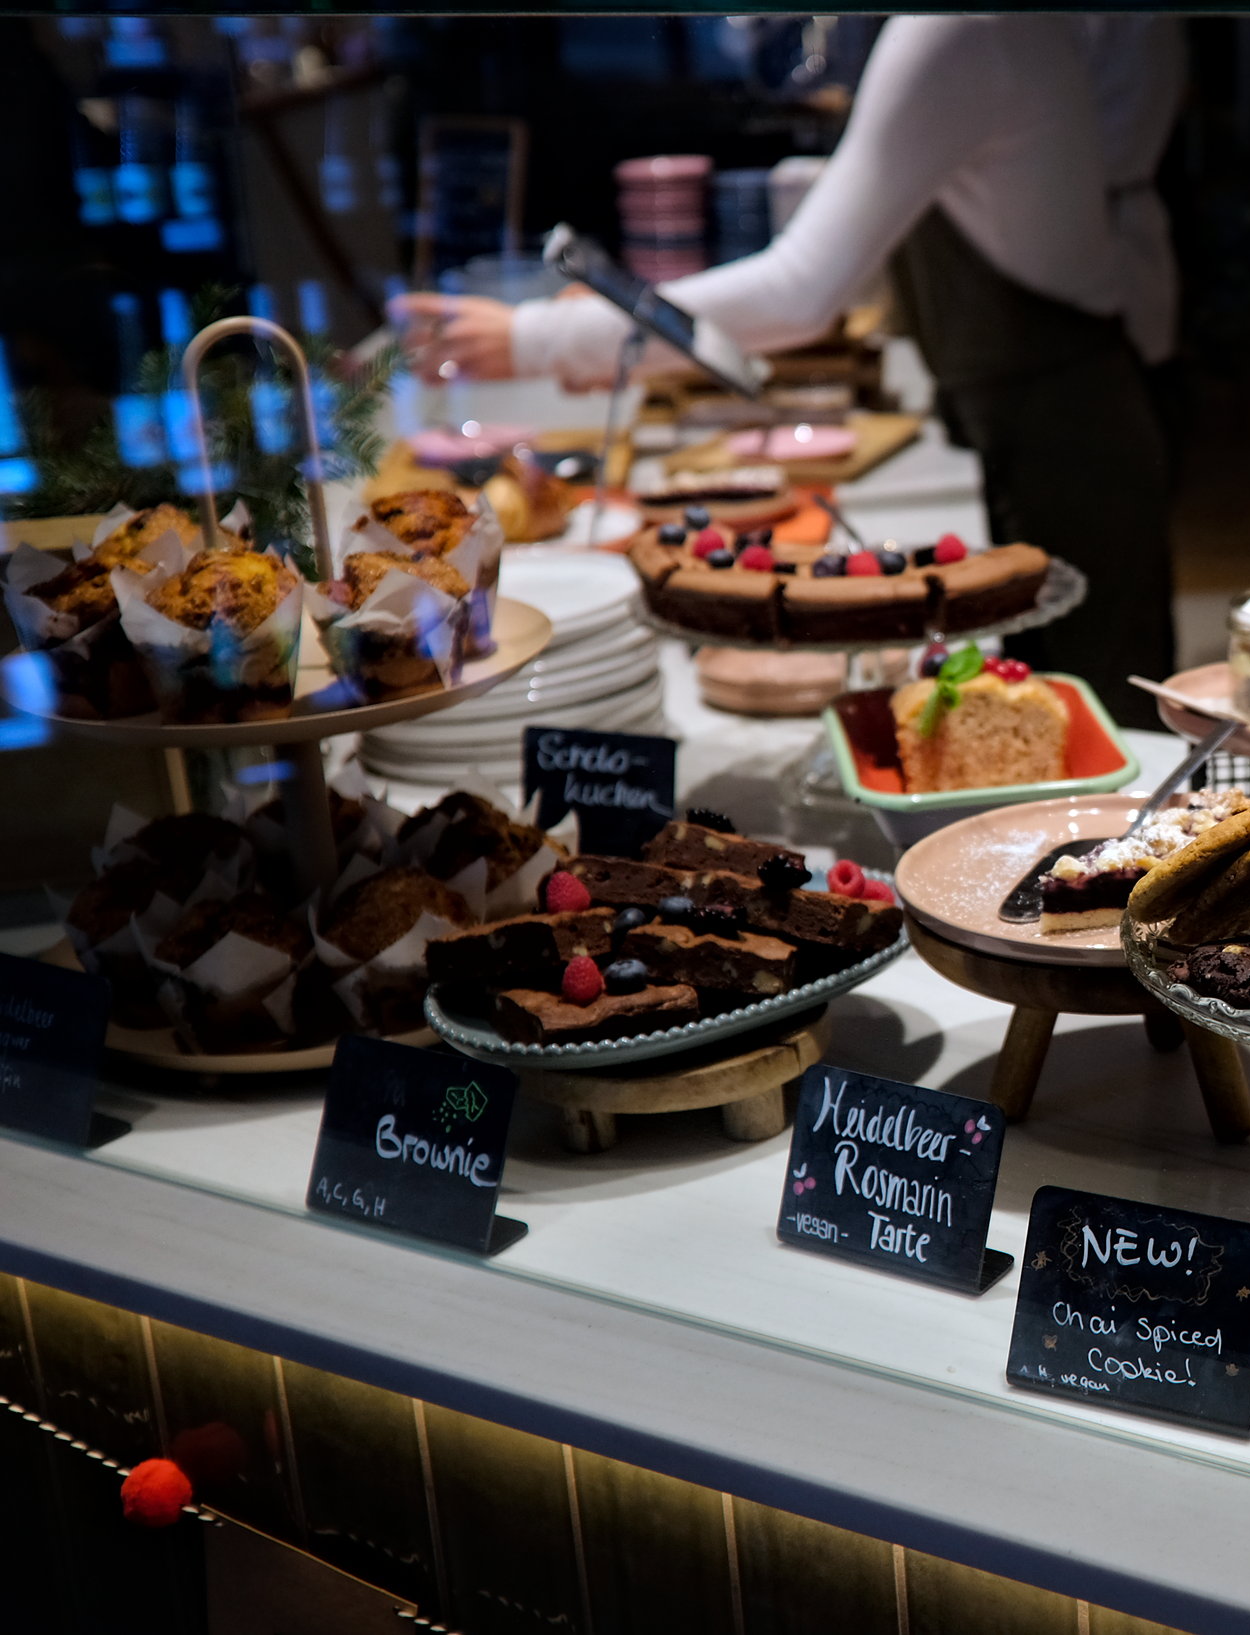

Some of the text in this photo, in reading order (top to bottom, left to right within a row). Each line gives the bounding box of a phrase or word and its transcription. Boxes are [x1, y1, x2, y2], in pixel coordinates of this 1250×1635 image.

[376, 1114, 498, 1187] Brownie
[834, 1140, 952, 1227] Rosmarin
[867, 1211, 931, 1263] Tarte
[1081, 1224, 1199, 1276] NEW!
[1052, 1301, 1223, 1355] Chai Spiced
[1087, 1348, 1197, 1387] Cookie!
